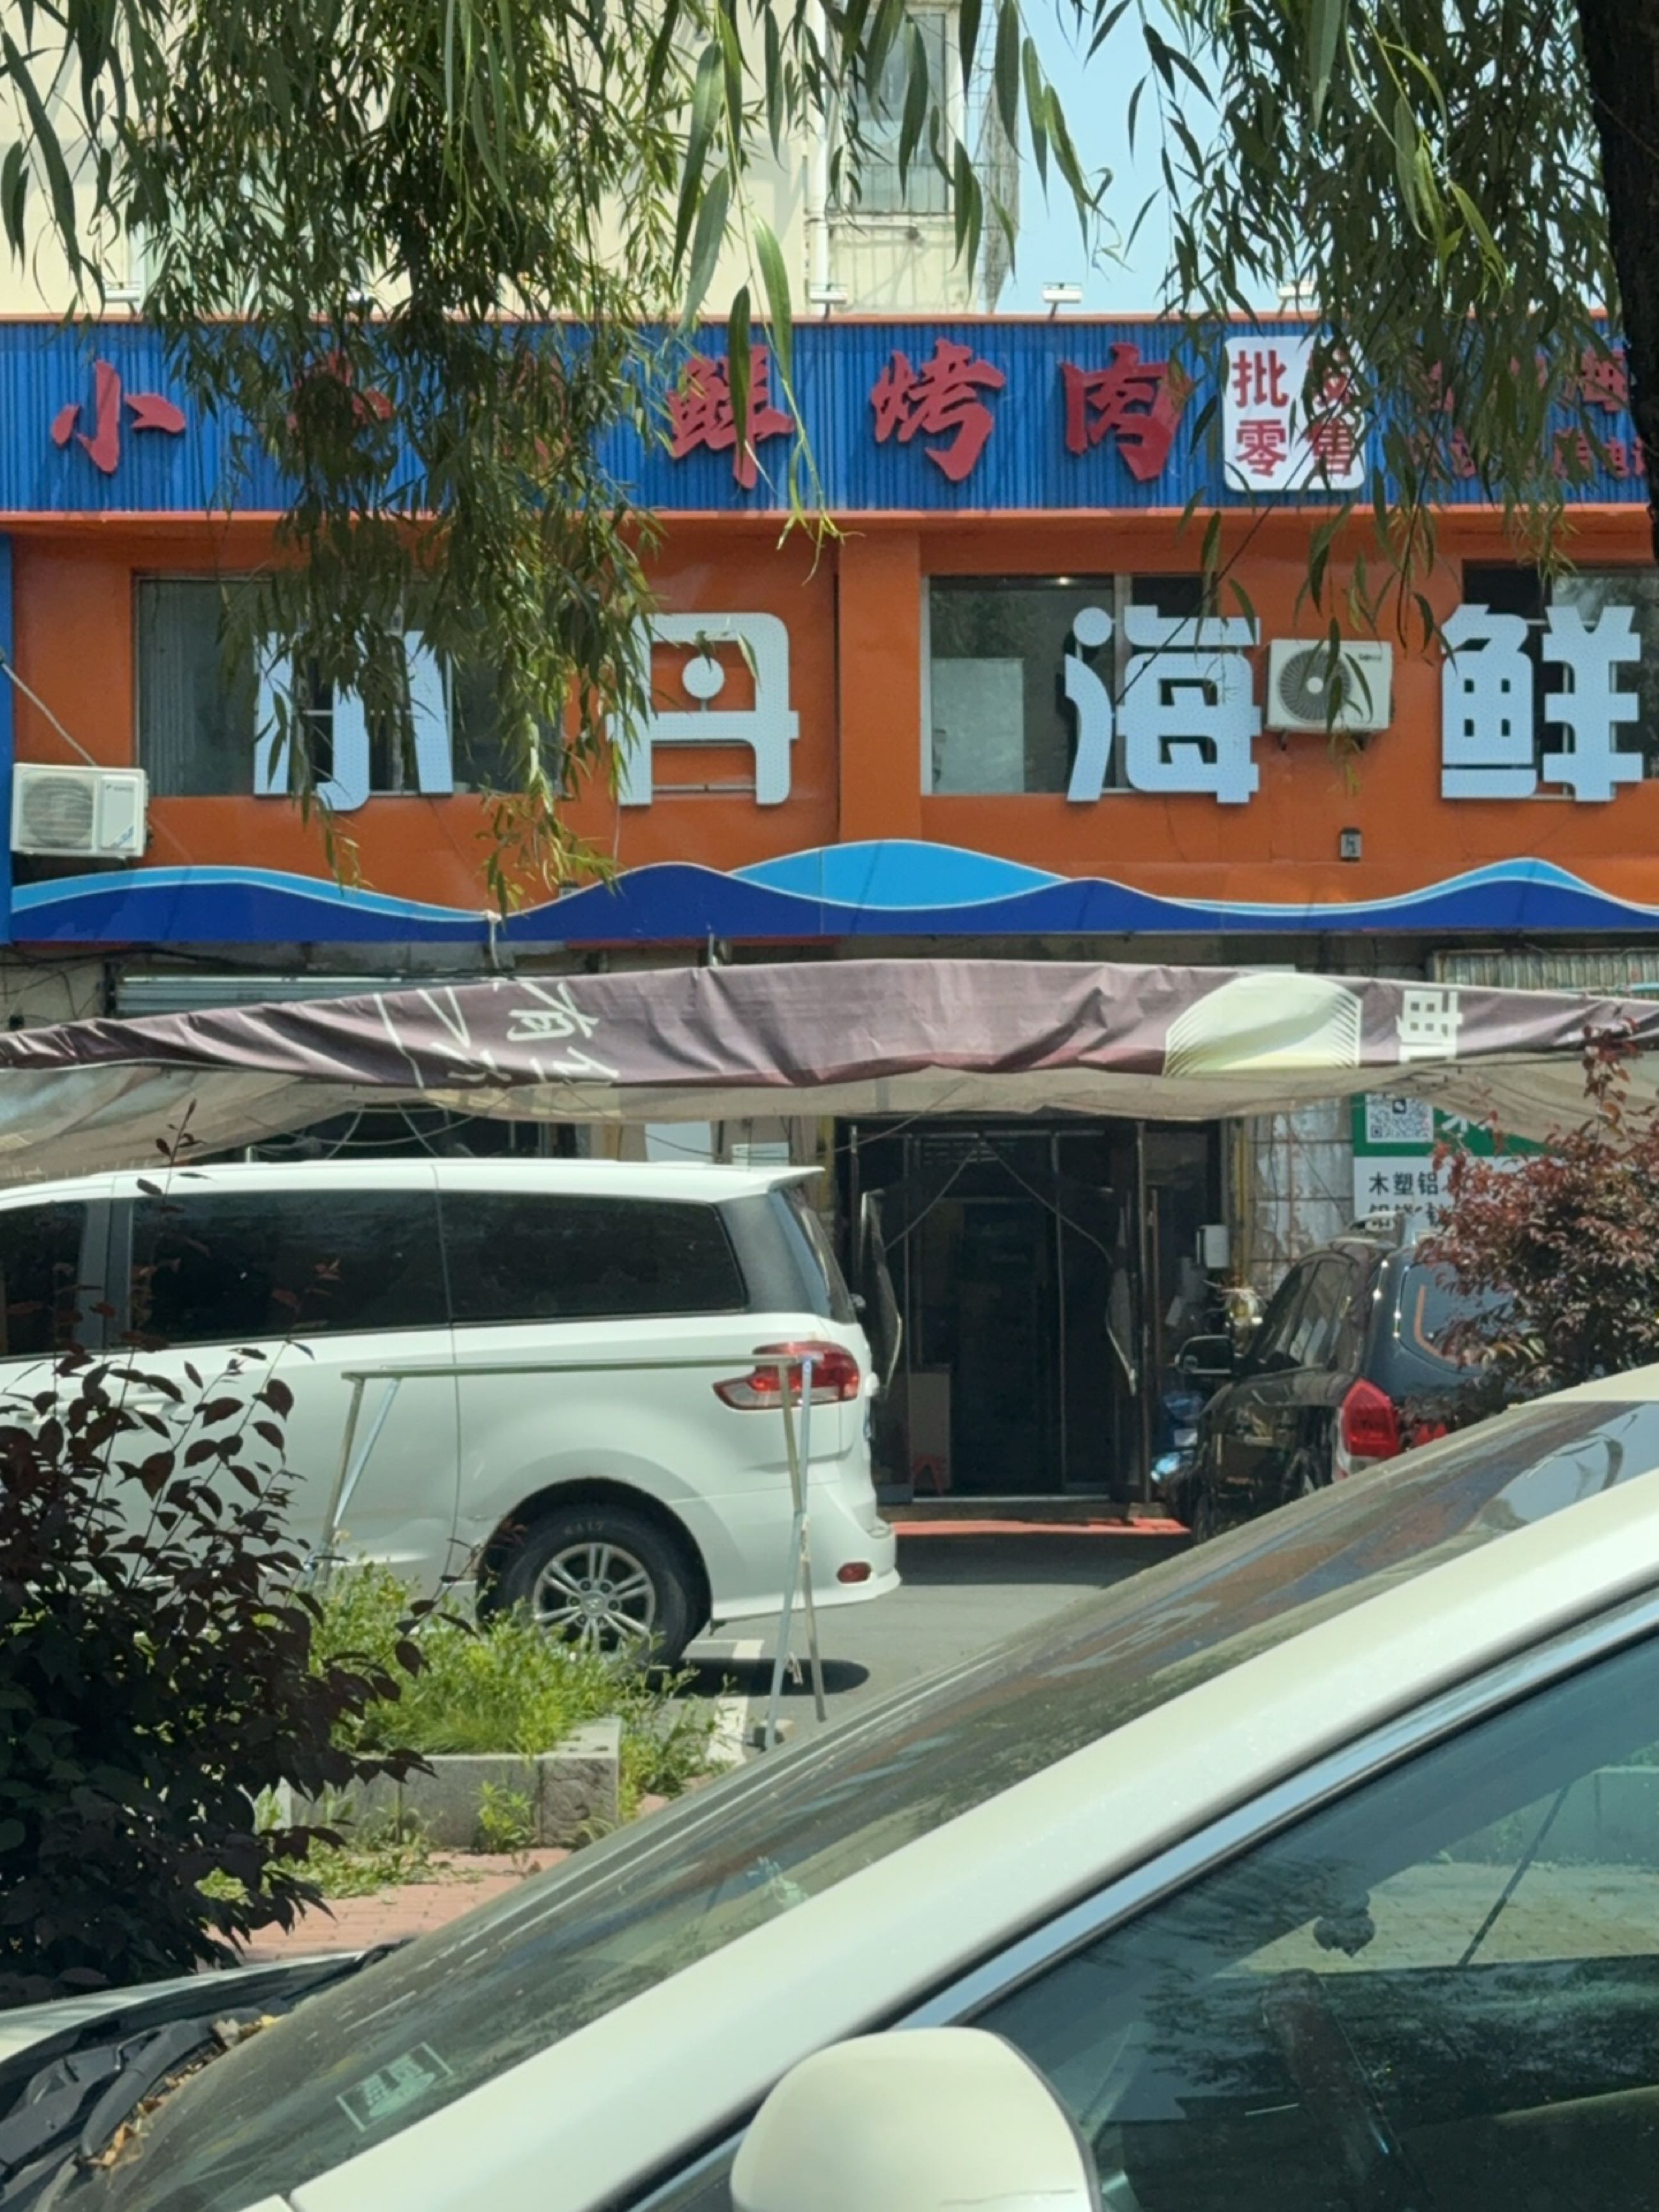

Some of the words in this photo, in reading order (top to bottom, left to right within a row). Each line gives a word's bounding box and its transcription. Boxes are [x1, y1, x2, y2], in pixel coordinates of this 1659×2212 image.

[51, 337, 1194, 490] 小鲜烤肉
[1369, 1171, 1450, 1196] 木塑铝
